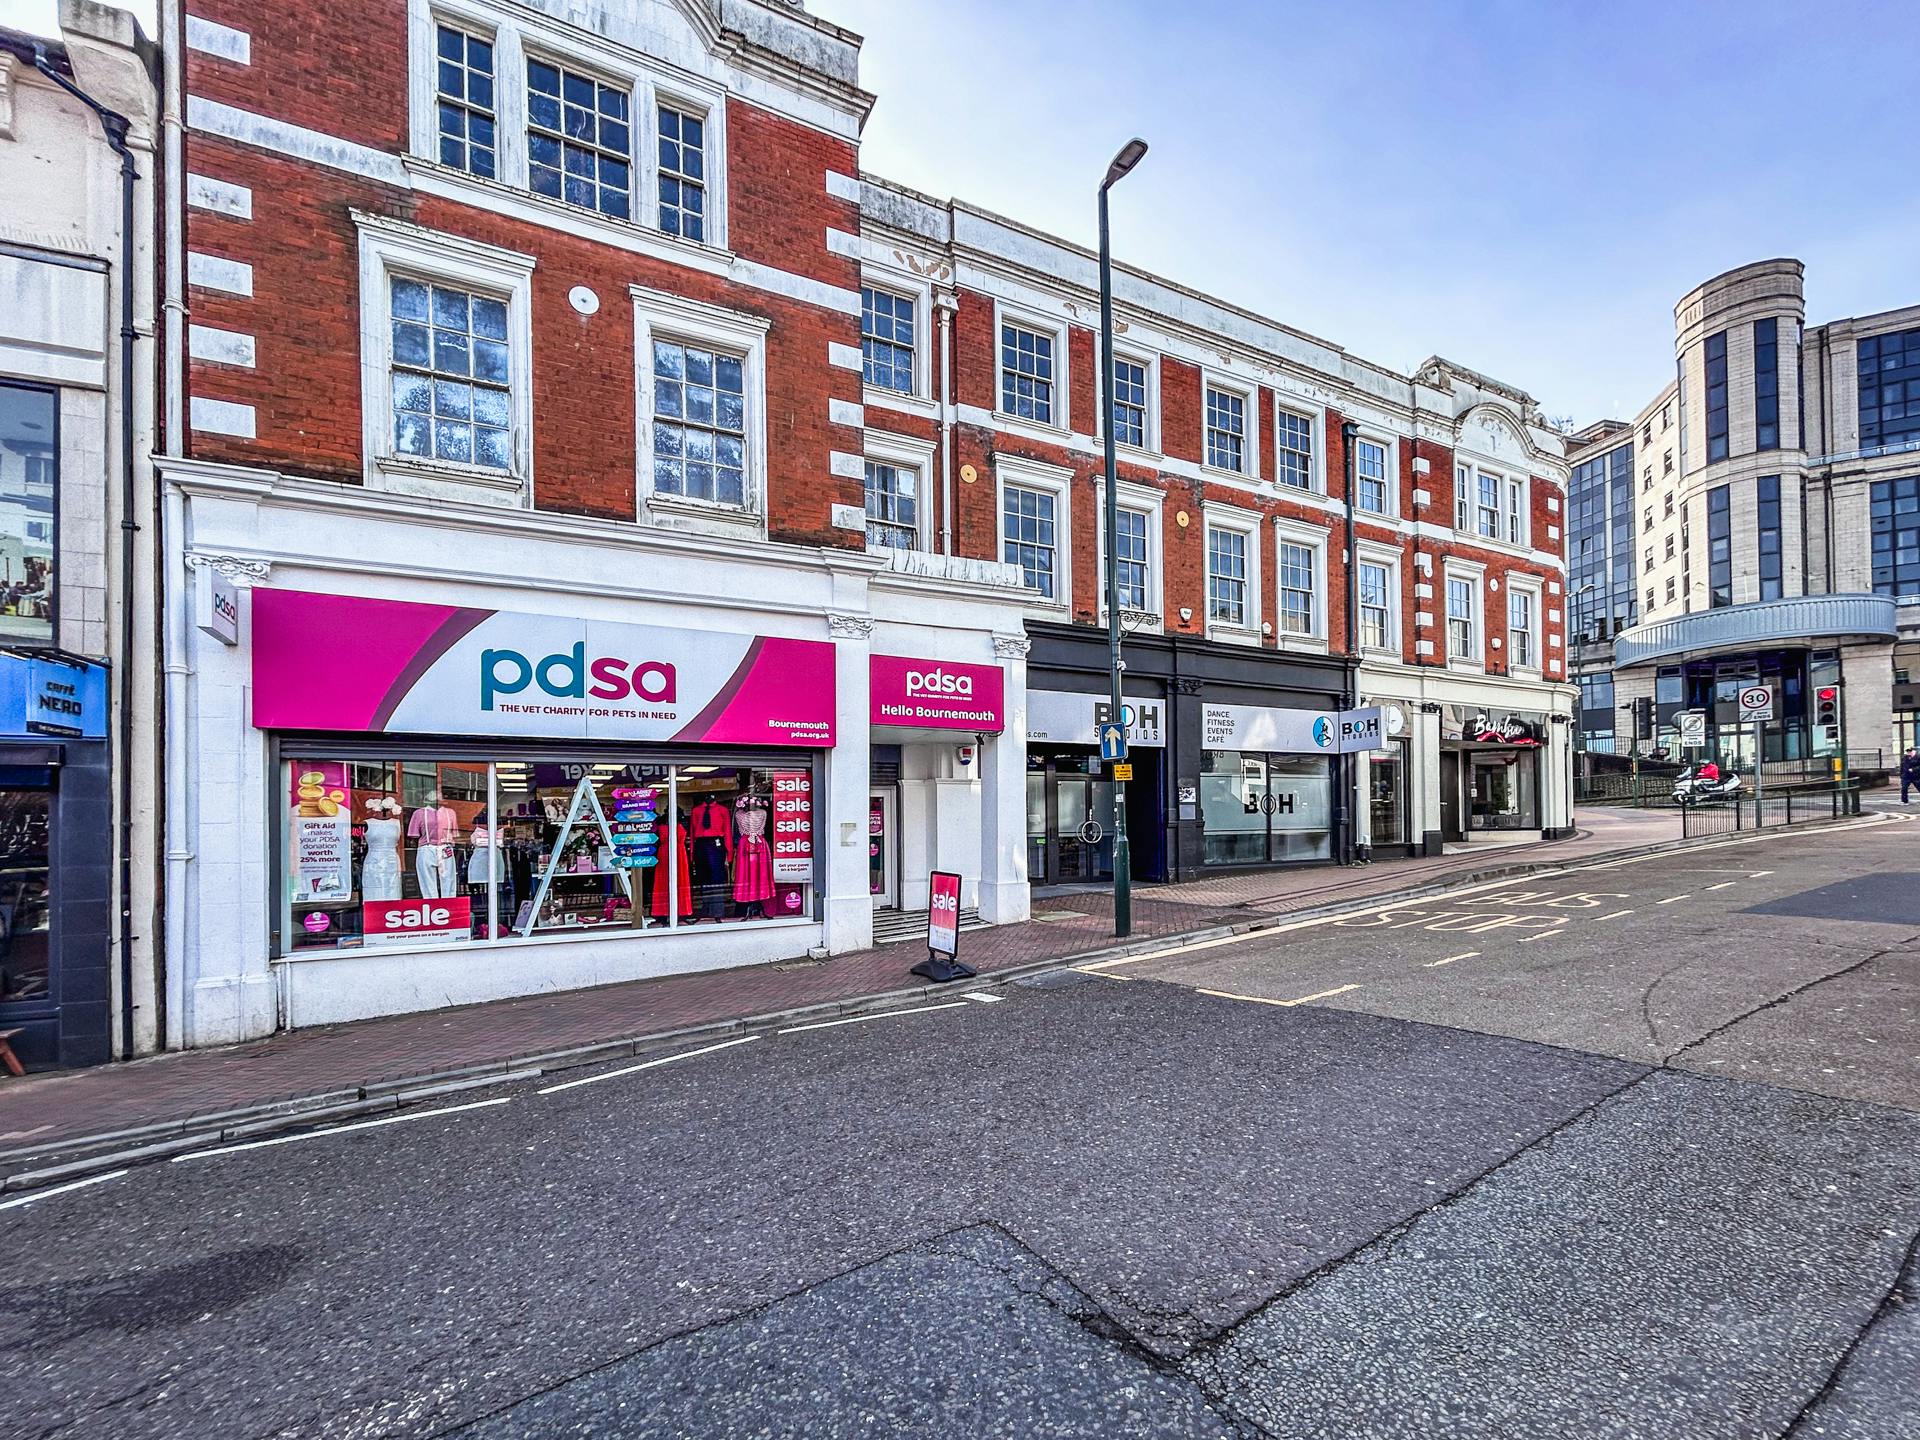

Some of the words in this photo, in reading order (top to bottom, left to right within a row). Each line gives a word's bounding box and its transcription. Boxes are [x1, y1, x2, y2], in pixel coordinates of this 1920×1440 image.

[215, 593, 235, 620] pdsa
[481, 641, 676, 711] pdsa
[906, 667, 972, 696] pdsa
[39, 694, 82, 716] NERO
[1746, 693, 1766, 704] 30
[500, 704, 520, 712] THE
[522, 705, 540, 713] VET
[543, 706, 585, 716] CHARITY
[589, 708, 609, 717] FOR
[612, 709, 636, 718] PETS
[639, 711, 649, 719] IN
[651, 711, 677, 720] NEED
[881, 704, 913, 716] Hello
[916, 706, 995, 721] Bournemouth
[1095, 702, 1158, 729] BOH
[1207, 710, 1230, 718] DANCE
[768, 720, 829, 730] Bournemouth
[1342, 718, 1379, 734] BOH
[791, 731, 829, 739] pdsa.org.uk
[1094, 727, 1158, 740] SDIOS
[1207, 735, 1225, 743] CAFÉ
[776, 778, 810, 792] sale
[776, 798, 810, 812] sale
[1244, 793, 1294, 815] BOH
[776, 818, 810, 832] sale
[776, 838, 810, 852] sale
[932, 890, 957, 912] sale
[1454, 891, 1630, 908] BUS
[385, 904, 450, 928] sale
[1333, 910, 1569, 934] STOP
